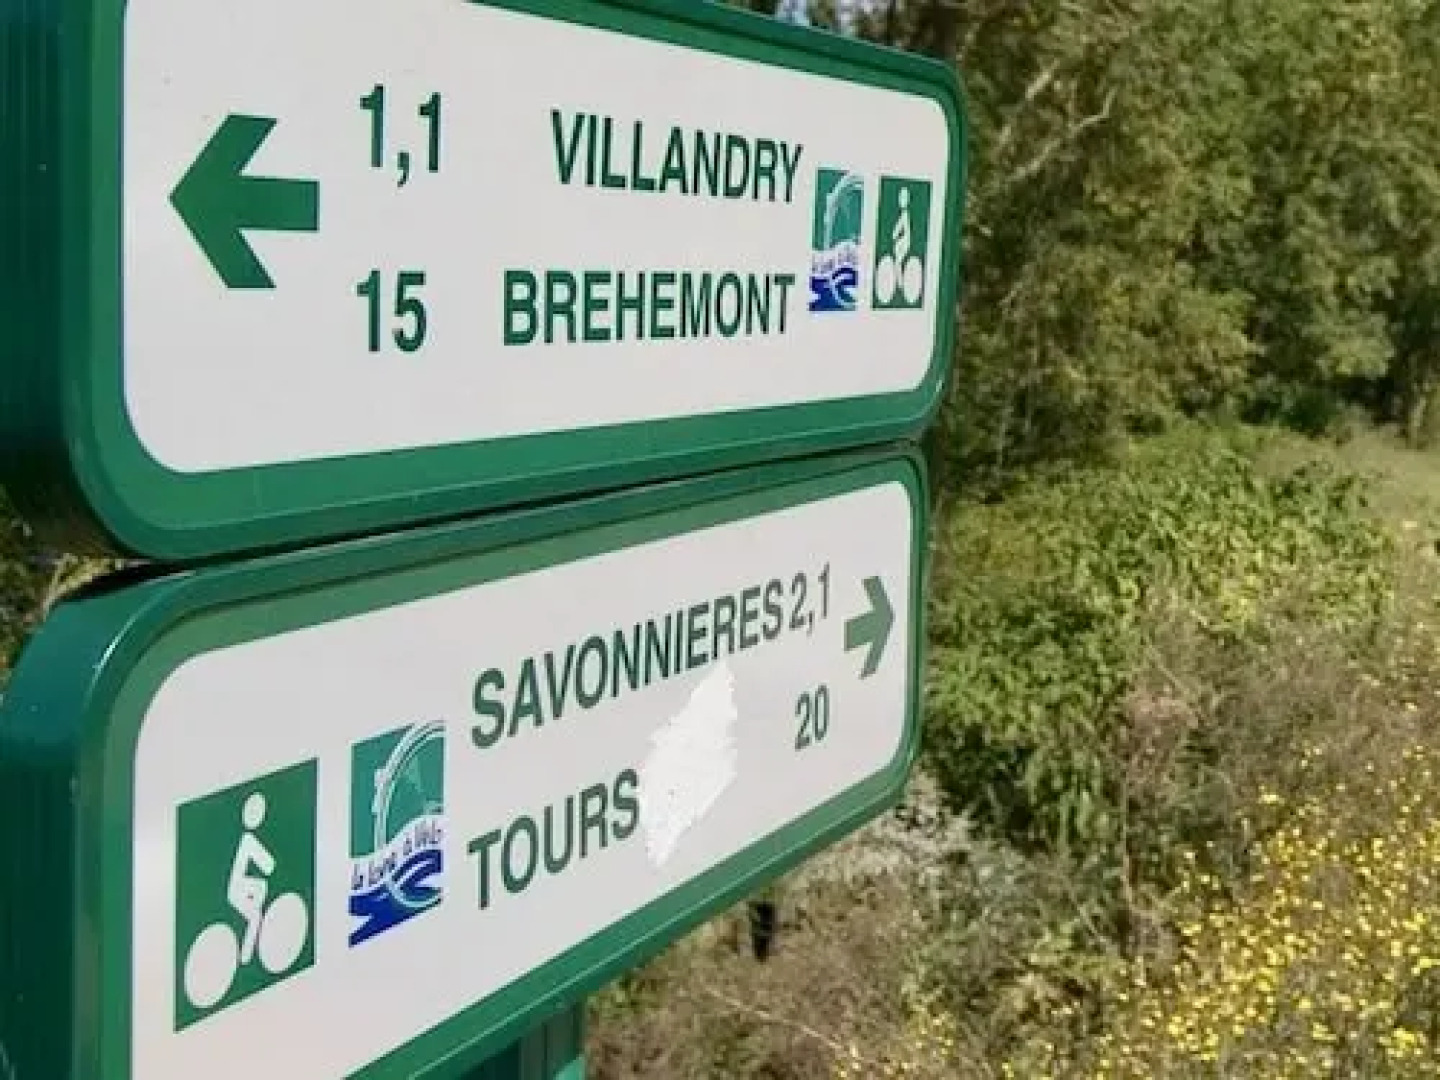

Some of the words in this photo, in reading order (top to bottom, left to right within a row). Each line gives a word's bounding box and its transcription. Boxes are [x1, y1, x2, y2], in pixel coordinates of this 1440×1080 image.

[359, 83, 442, 187] 1,1
[549, 108, 804, 204] VILLANDRY
[356, 269, 428, 353] 15
[502, 269, 796, 347] BREHEMONT
[471, 577, 784, 750] SAVONNIERES
[788, 562, 830, 636] 2,1
[466, 767, 641, 911] TOURS
[794, 684, 831, 750] 20
